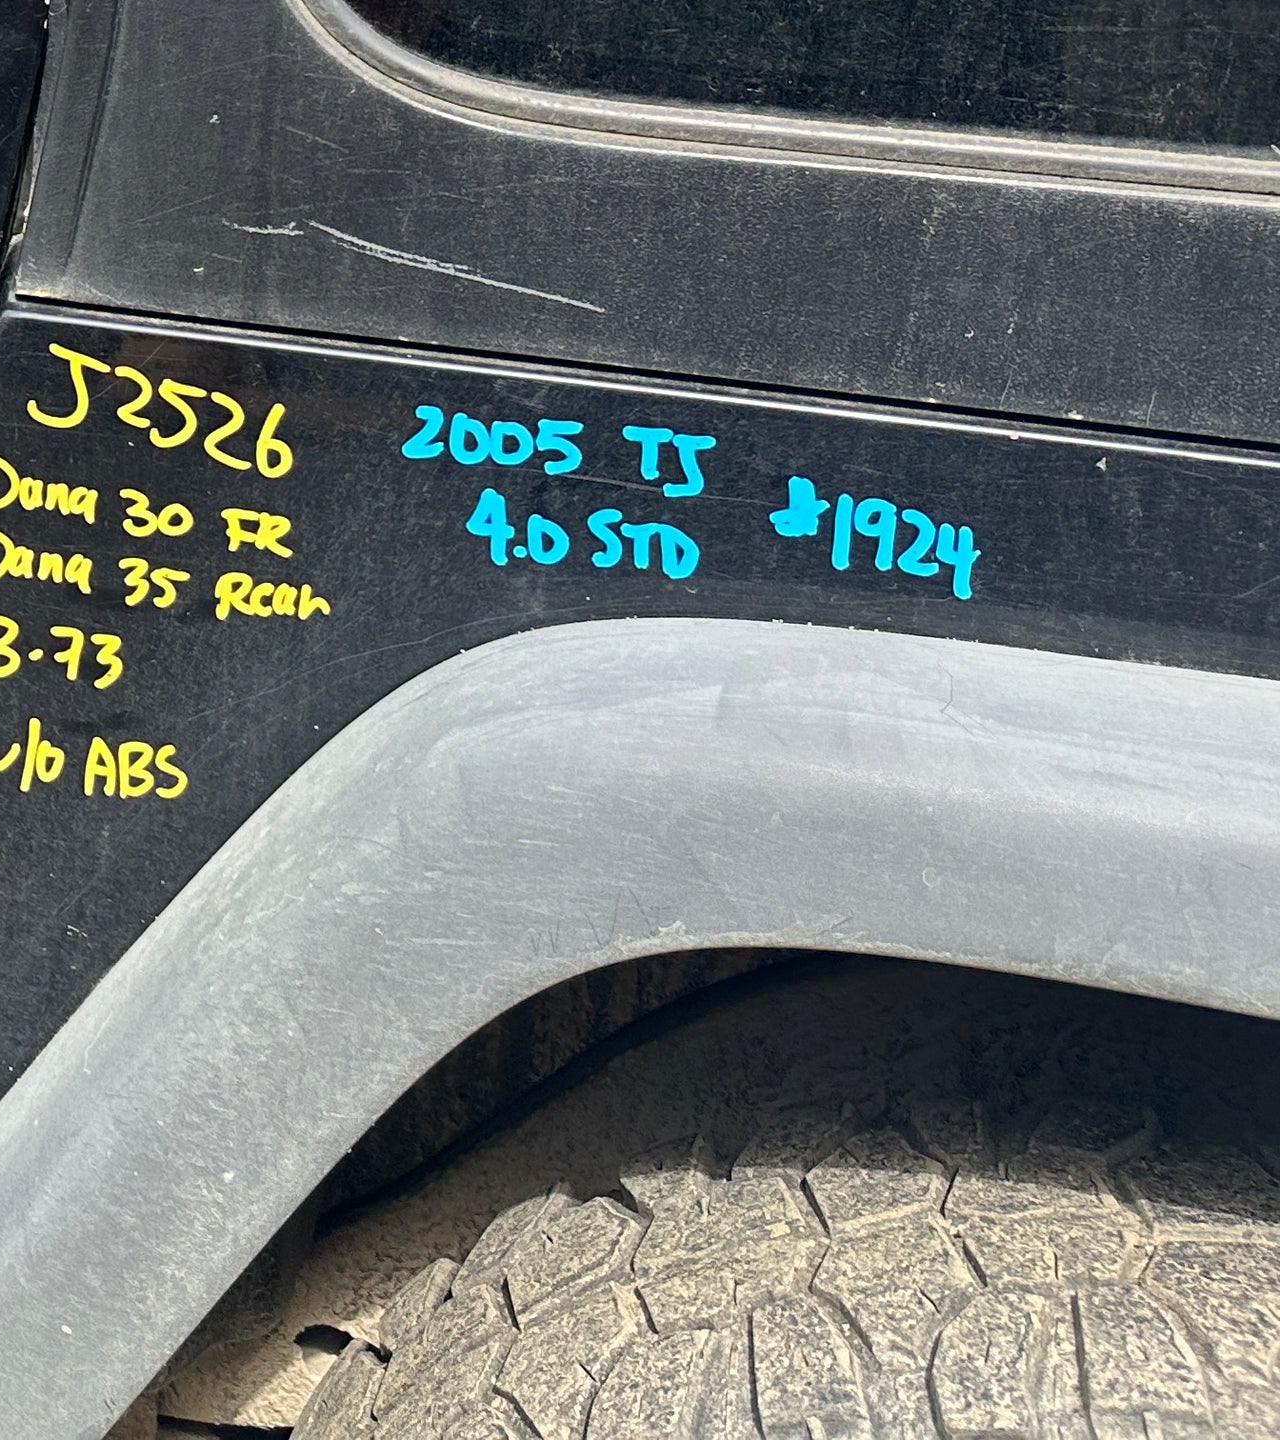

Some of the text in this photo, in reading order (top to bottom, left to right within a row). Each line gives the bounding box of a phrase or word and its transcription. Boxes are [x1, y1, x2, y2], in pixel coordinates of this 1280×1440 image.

[27, 343, 293, 478] J2526
[402, 405, 717, 498] 2005 TJ
[119, 488, 194, 538] 30
[220, 508, 293, 558] FR
[465, 488, 701, 580] 4.0 STD
[118, 558, 191, 608] 35
[83, 736, 190, 800] ABS
